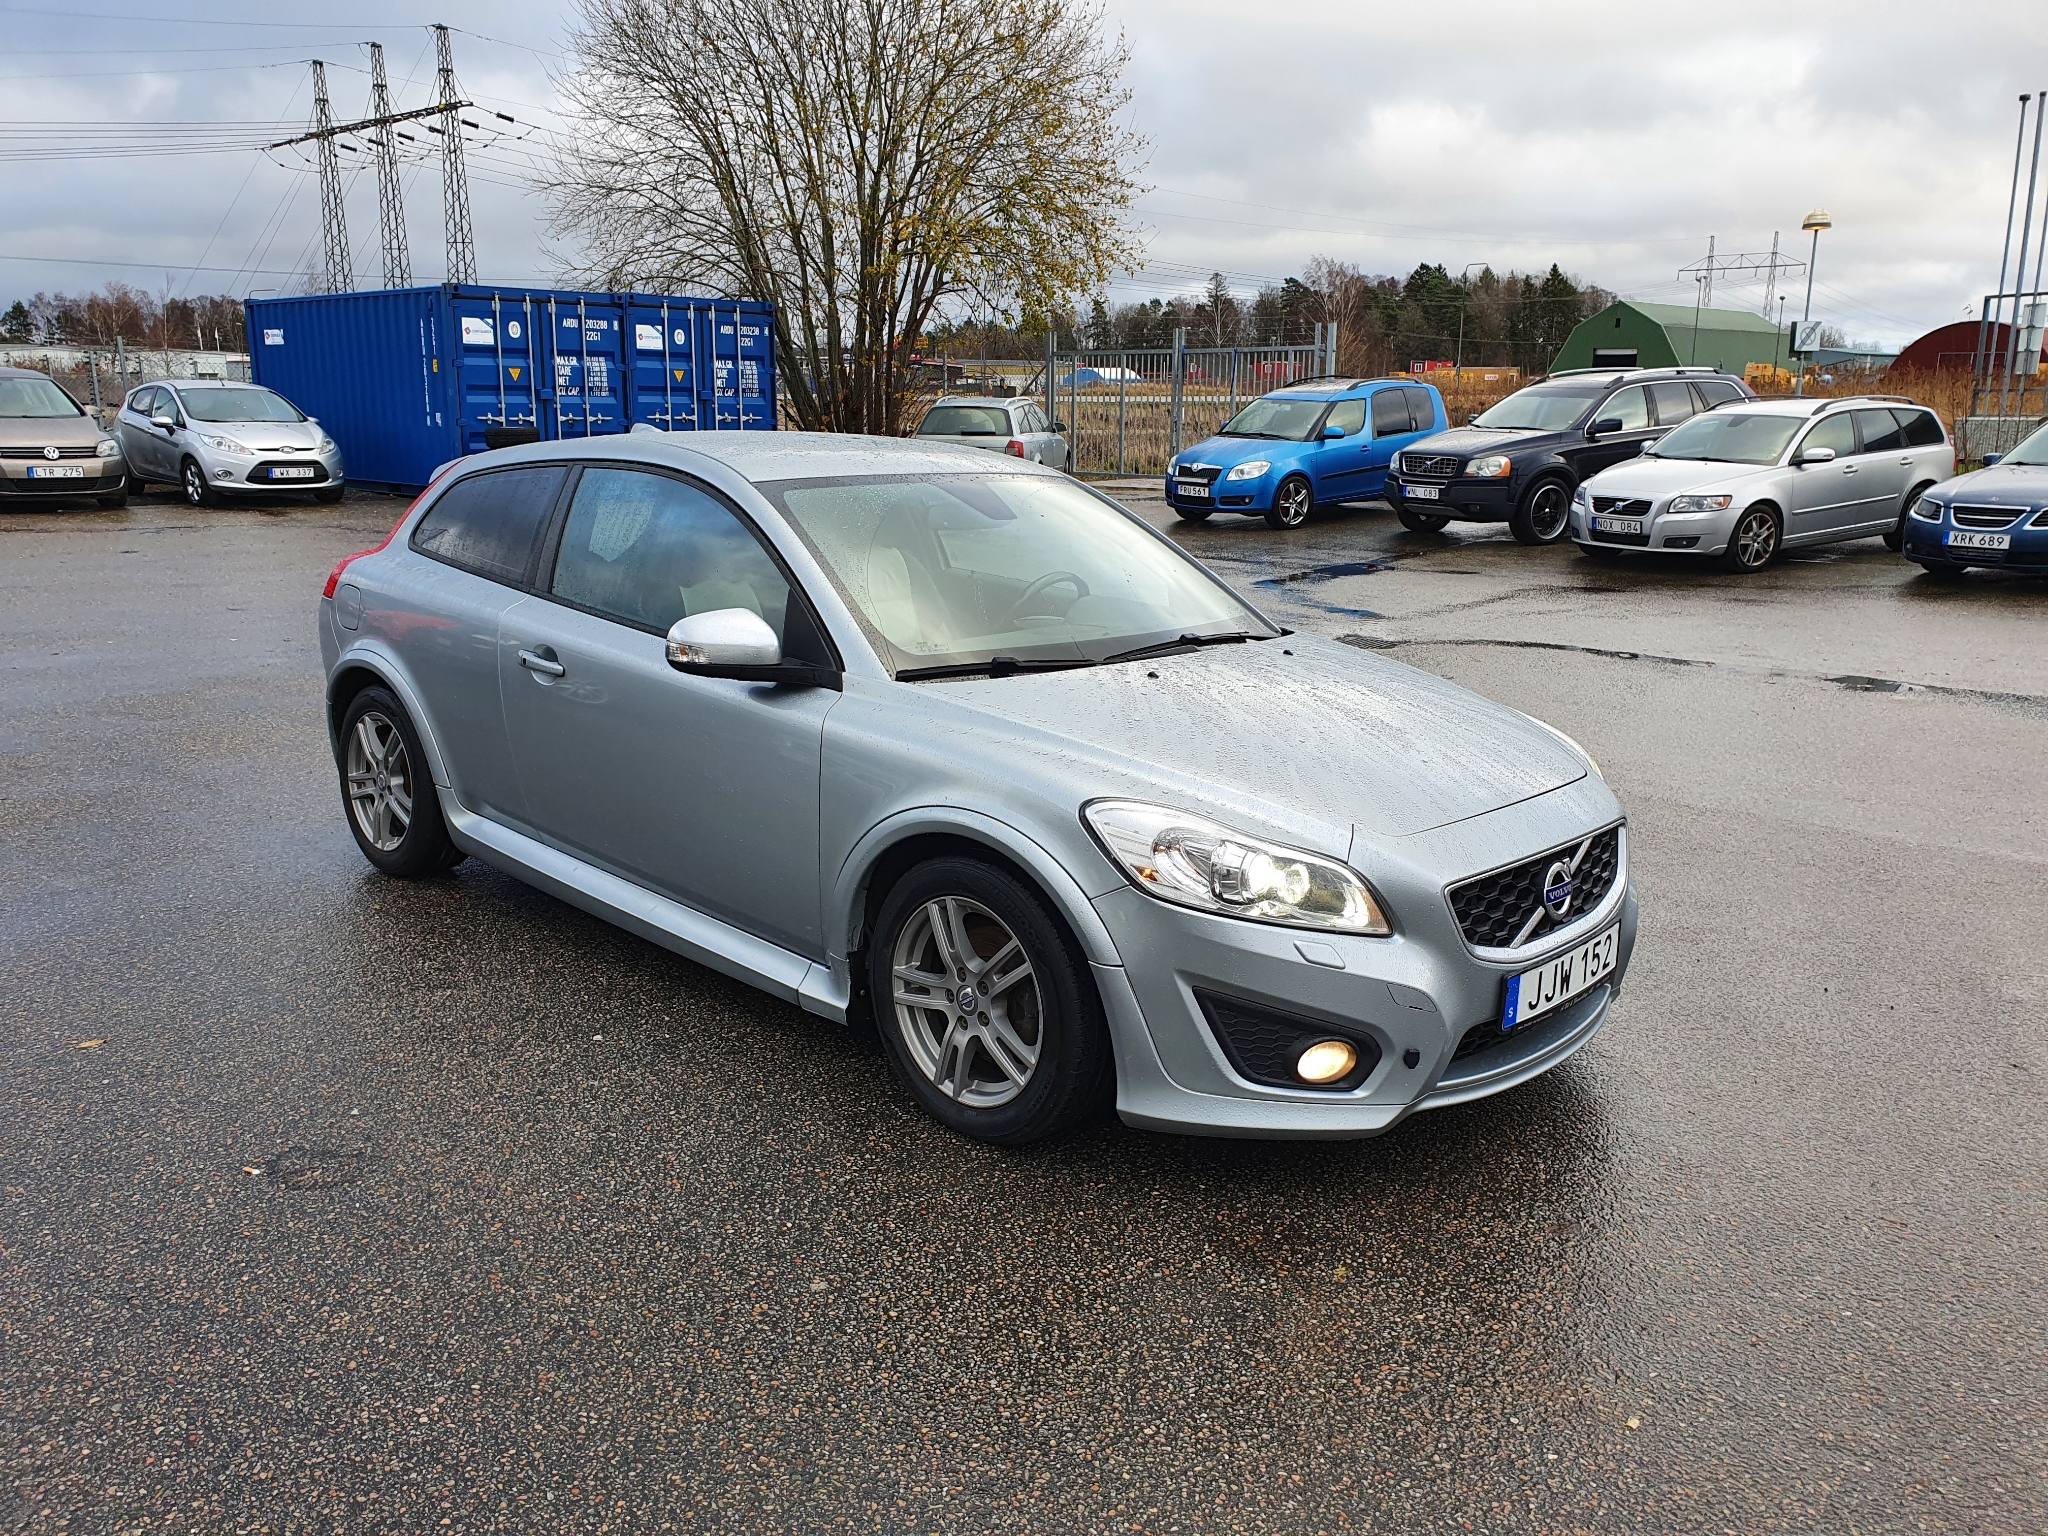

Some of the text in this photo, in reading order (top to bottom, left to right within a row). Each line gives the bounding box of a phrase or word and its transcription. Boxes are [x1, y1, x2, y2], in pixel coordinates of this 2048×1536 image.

[563, 318, 579, 328] ARDU
[586, 320, 607, 329] 203288
[720, 325, 734, 334] ARDU
[741, 326, 759, 335] 203238
[586, 331, 601, 341] 22G1
[558, 366, 572, 375] TARE
[716, 369, 728, 378] TARE
[559, 377, 569, 386] NET
[716, 379, 726, 387] NET
[35, 468, 81, 477] LTR 275
[273, 468, 312, 477] LWX 337
[1180, 485, 1205, 496] FRU 561
[1423, 489, 1437, 498] 083
[1597, 519, 1638, 532] NOX 084
[1952, 533, 2004, 547] XRK 689
[1528, 955, 1573, 1010] JJW
[1581, 933, 1612, 984] 152
[1508, 1007, 1514, 1018] S
